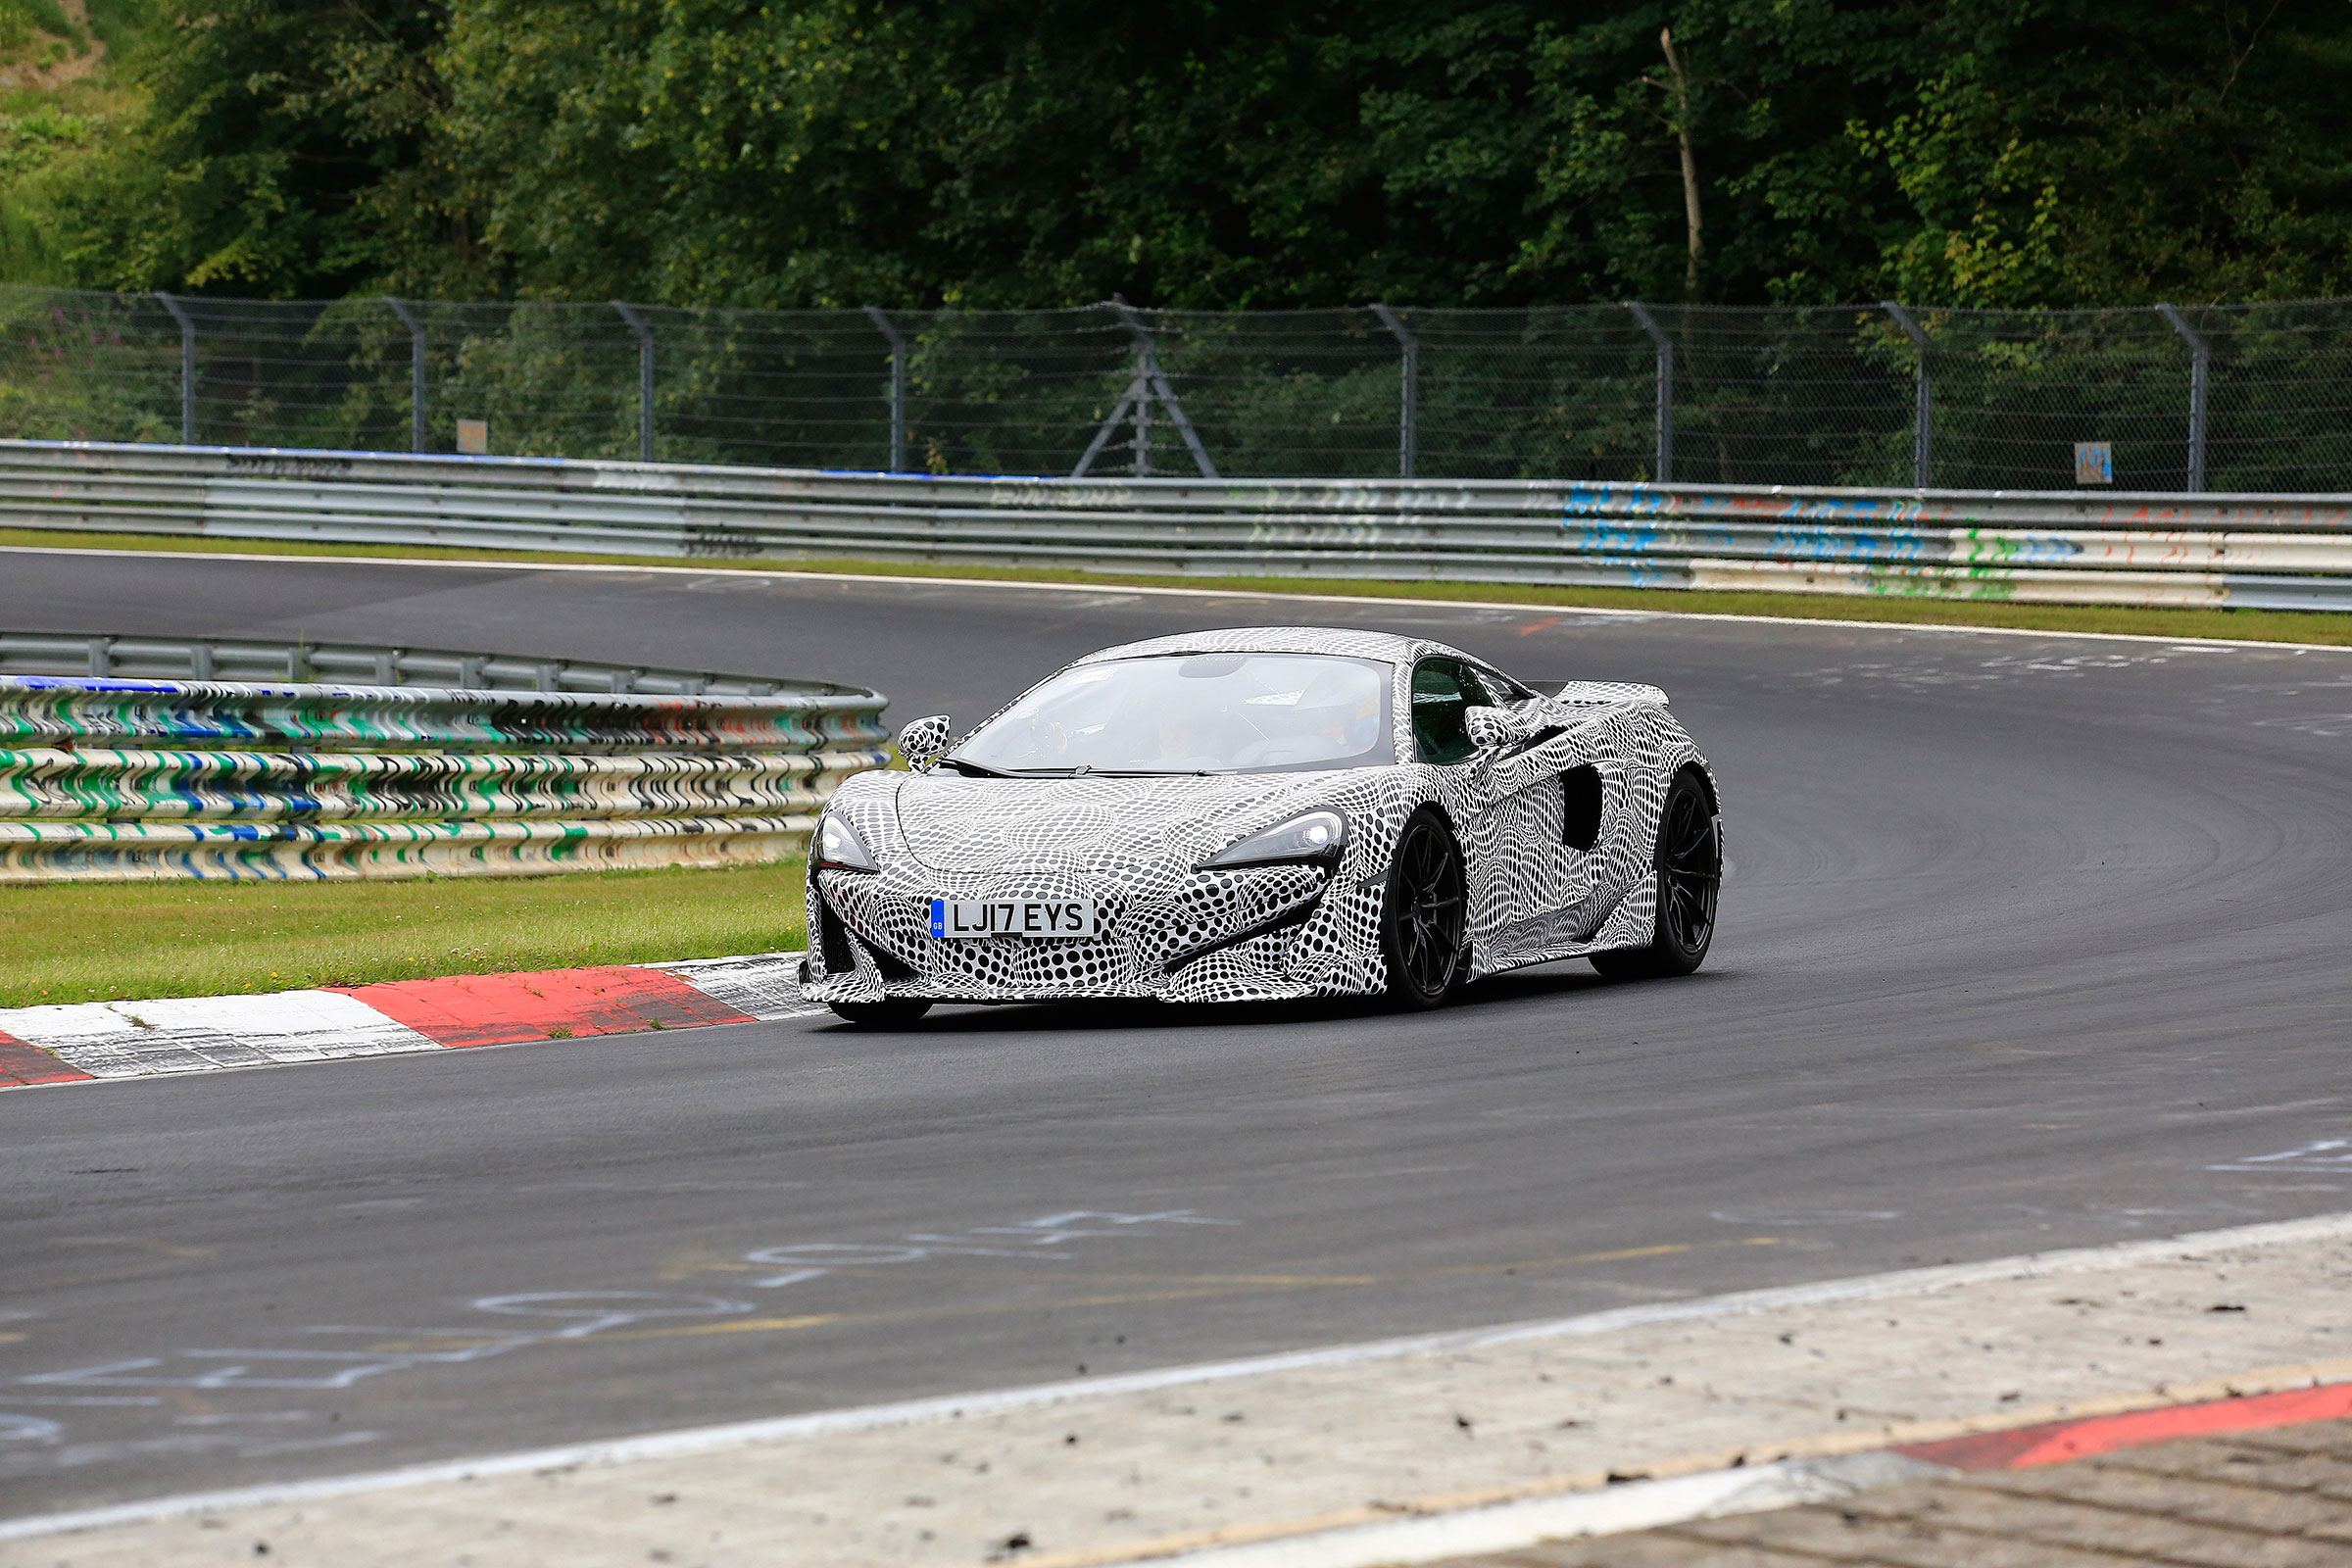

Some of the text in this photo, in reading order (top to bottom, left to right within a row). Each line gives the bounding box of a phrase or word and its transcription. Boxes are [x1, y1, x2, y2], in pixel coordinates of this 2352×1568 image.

[933, 921, 943, 930] GB
[954, 904, 1083, 932] LJ17 EYS
